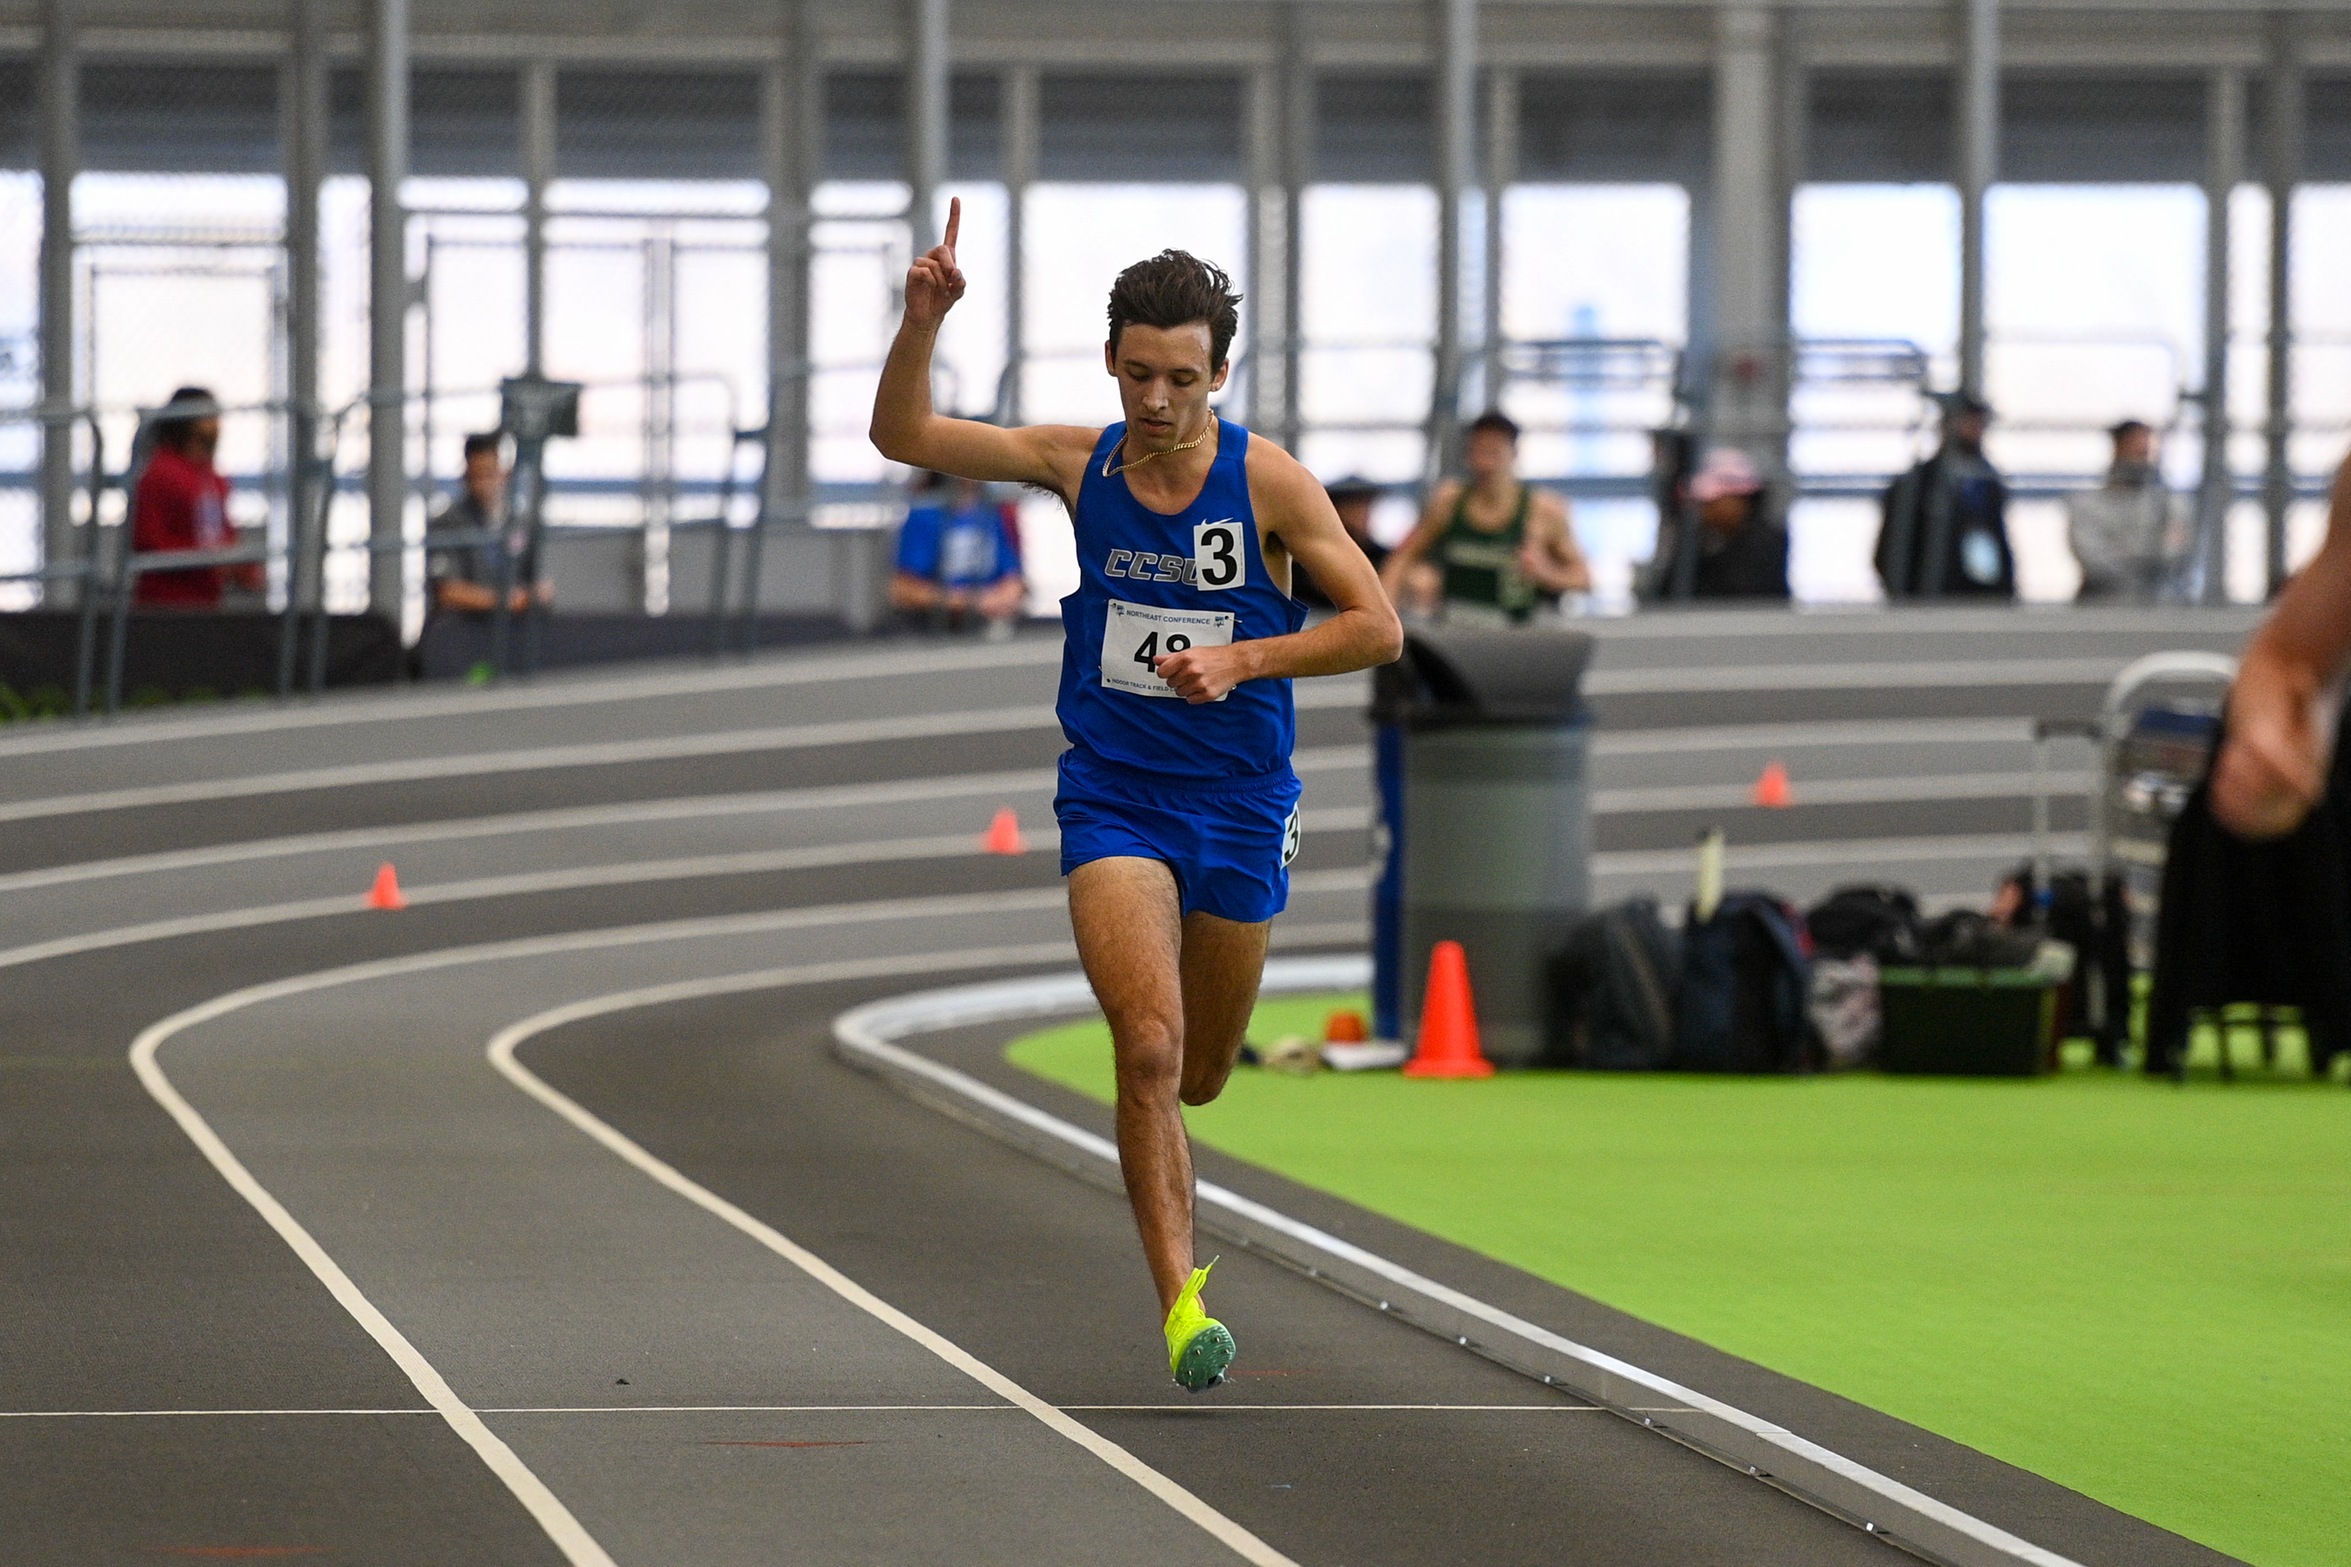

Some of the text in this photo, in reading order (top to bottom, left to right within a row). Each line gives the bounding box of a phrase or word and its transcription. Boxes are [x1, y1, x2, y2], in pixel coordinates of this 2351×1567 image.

[1200, 527, 1238, 586] 3
[1126, 609, 1162, 622] NORTHEAST
[1163, 616, 1211, 625] CONFERENCE
[1111, 678, 1130, 686] INDOOR
[1130, 681, 1147, 689] TRACK
[1284, 809, 1299, 863] 3
